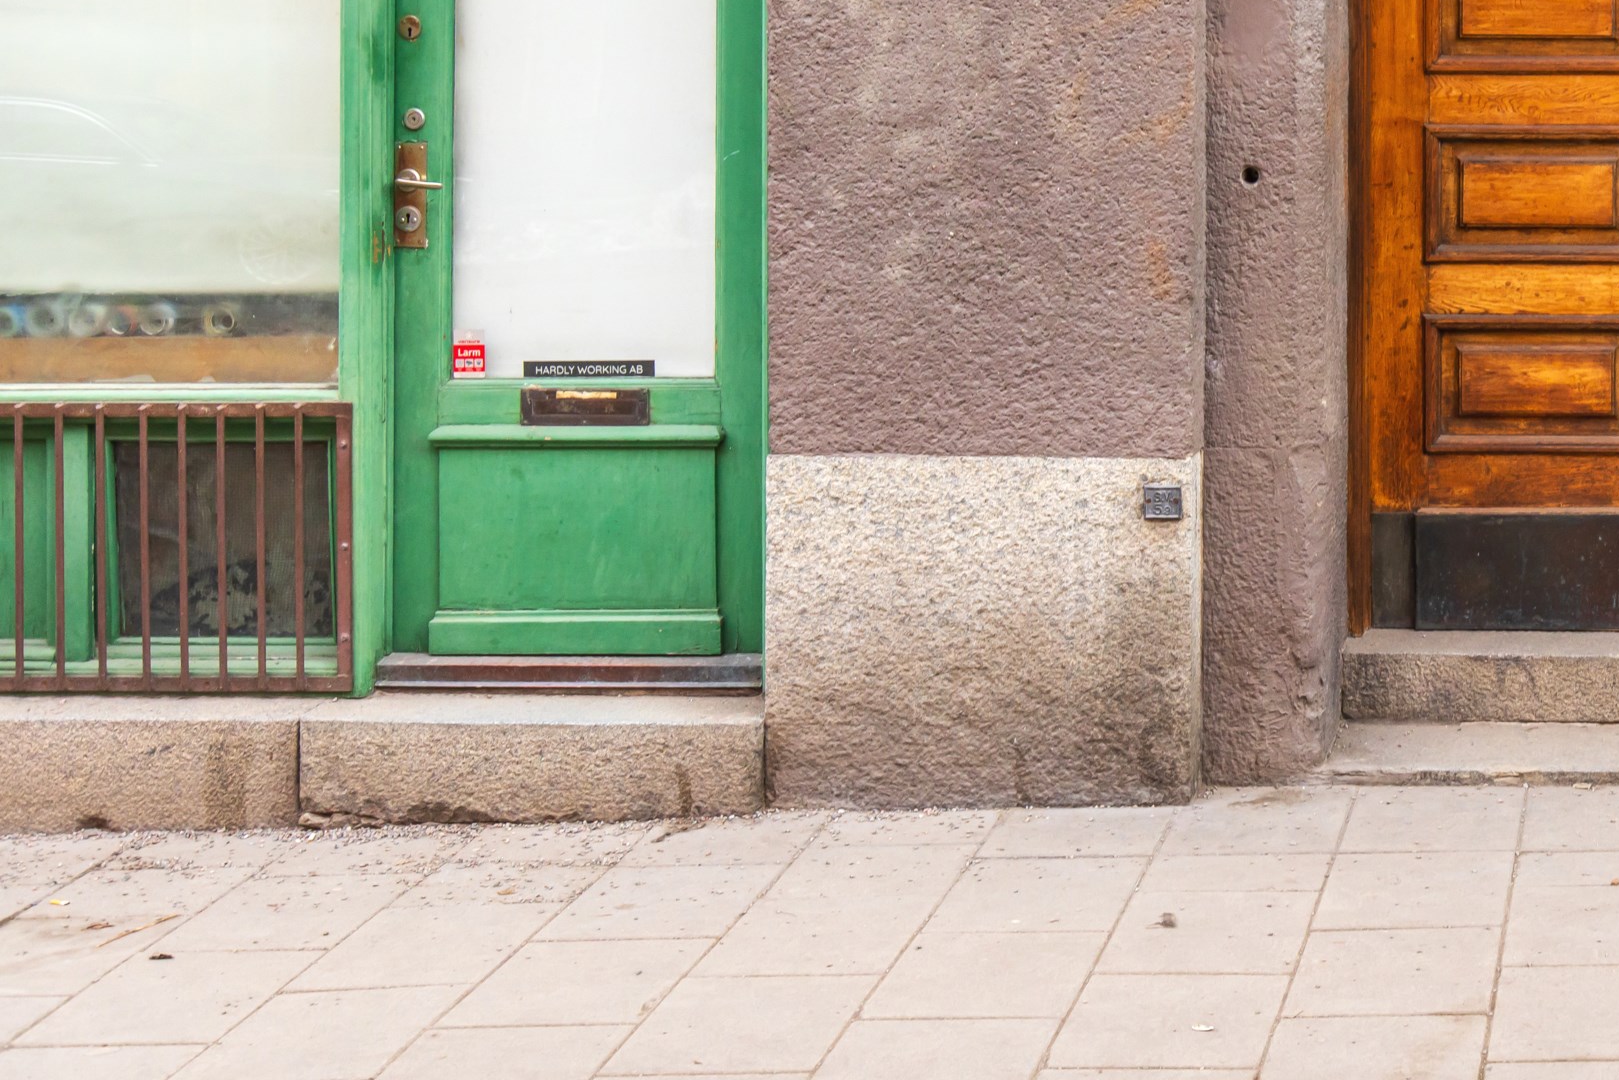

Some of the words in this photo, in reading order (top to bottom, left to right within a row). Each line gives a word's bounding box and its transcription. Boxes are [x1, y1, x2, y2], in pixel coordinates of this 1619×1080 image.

[458, 347, 481, 357] Larm
[535, 365, 575, 376] HARDLY
[578, 364, 627, 375] WORKING
[629, 364, 644, 375] AB
